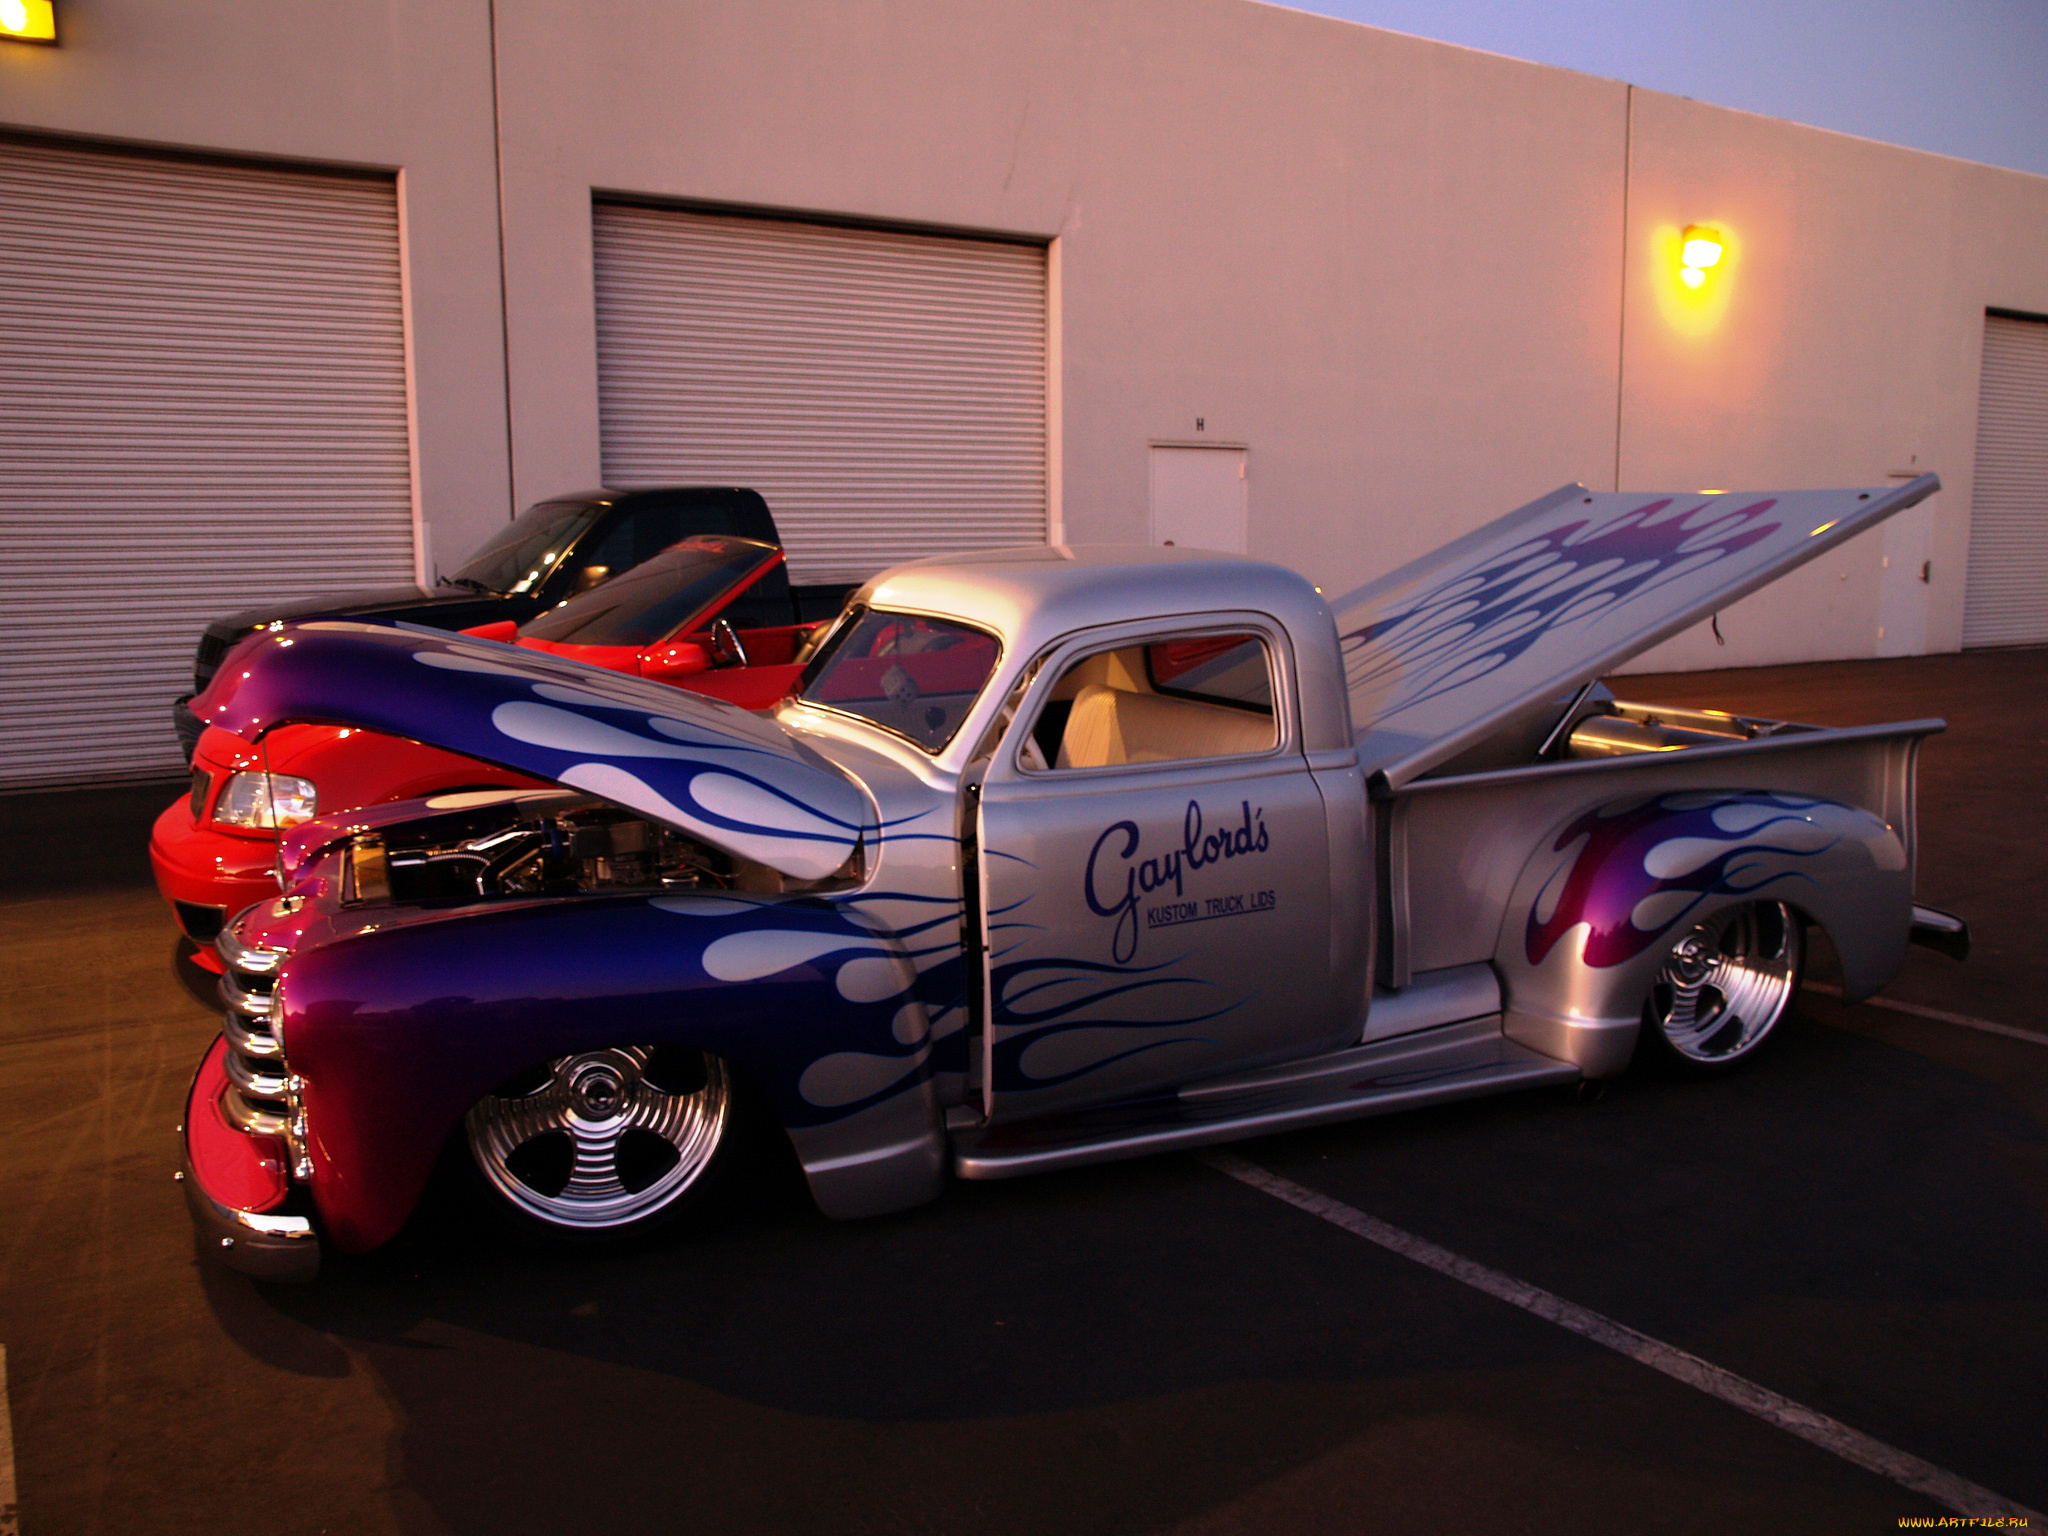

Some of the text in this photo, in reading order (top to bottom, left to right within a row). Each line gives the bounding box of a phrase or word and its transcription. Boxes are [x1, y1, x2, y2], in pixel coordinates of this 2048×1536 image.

[1196, 417, 1205, 431] H
[1085, 799, 1269, 964] Gaylord's
[1147, 889, 1275, 925] KUSTOM TRUCK LIDS
